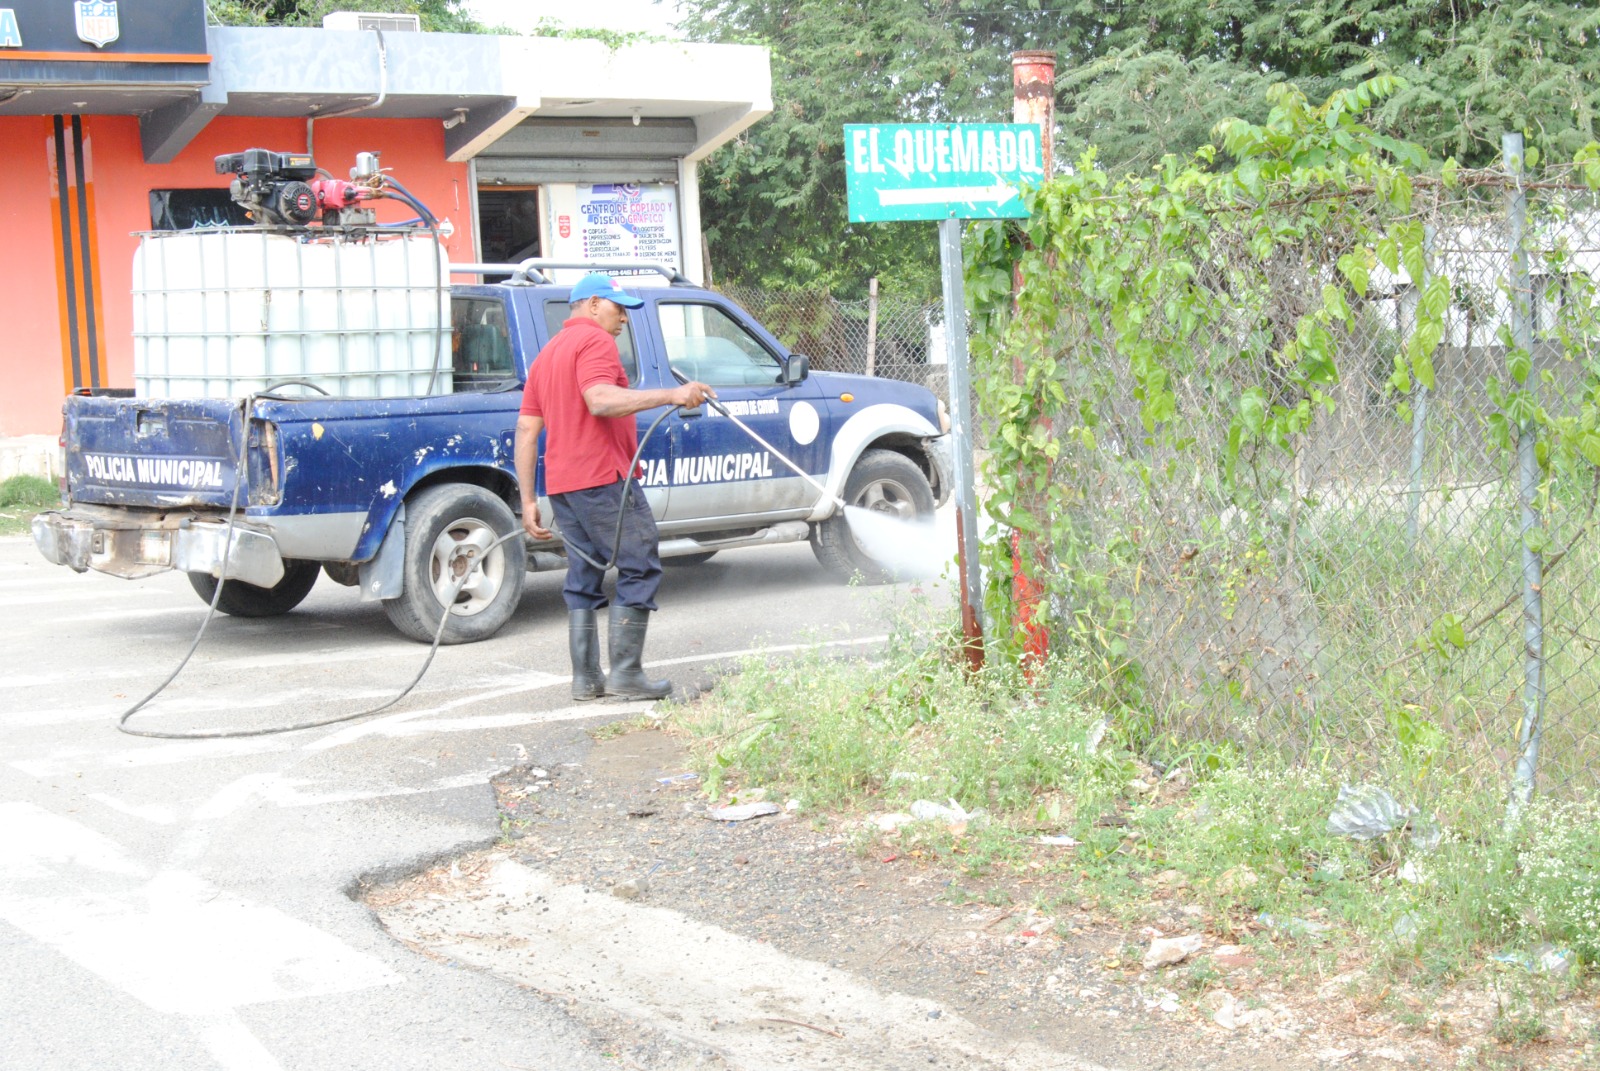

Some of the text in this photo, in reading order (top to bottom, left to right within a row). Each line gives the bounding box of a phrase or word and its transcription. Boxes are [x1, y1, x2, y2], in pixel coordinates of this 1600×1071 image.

[86, 18, 115, 38] NFL
[852, 128, 1037, 174] EL QUEMADO
[581, 202, 673, 215] CENTRO DE COPIADO Y
[85, 454, 223, 488] POLICIA MUNICIPAL
[673, 452, 773, 485] MUNICIPAL
